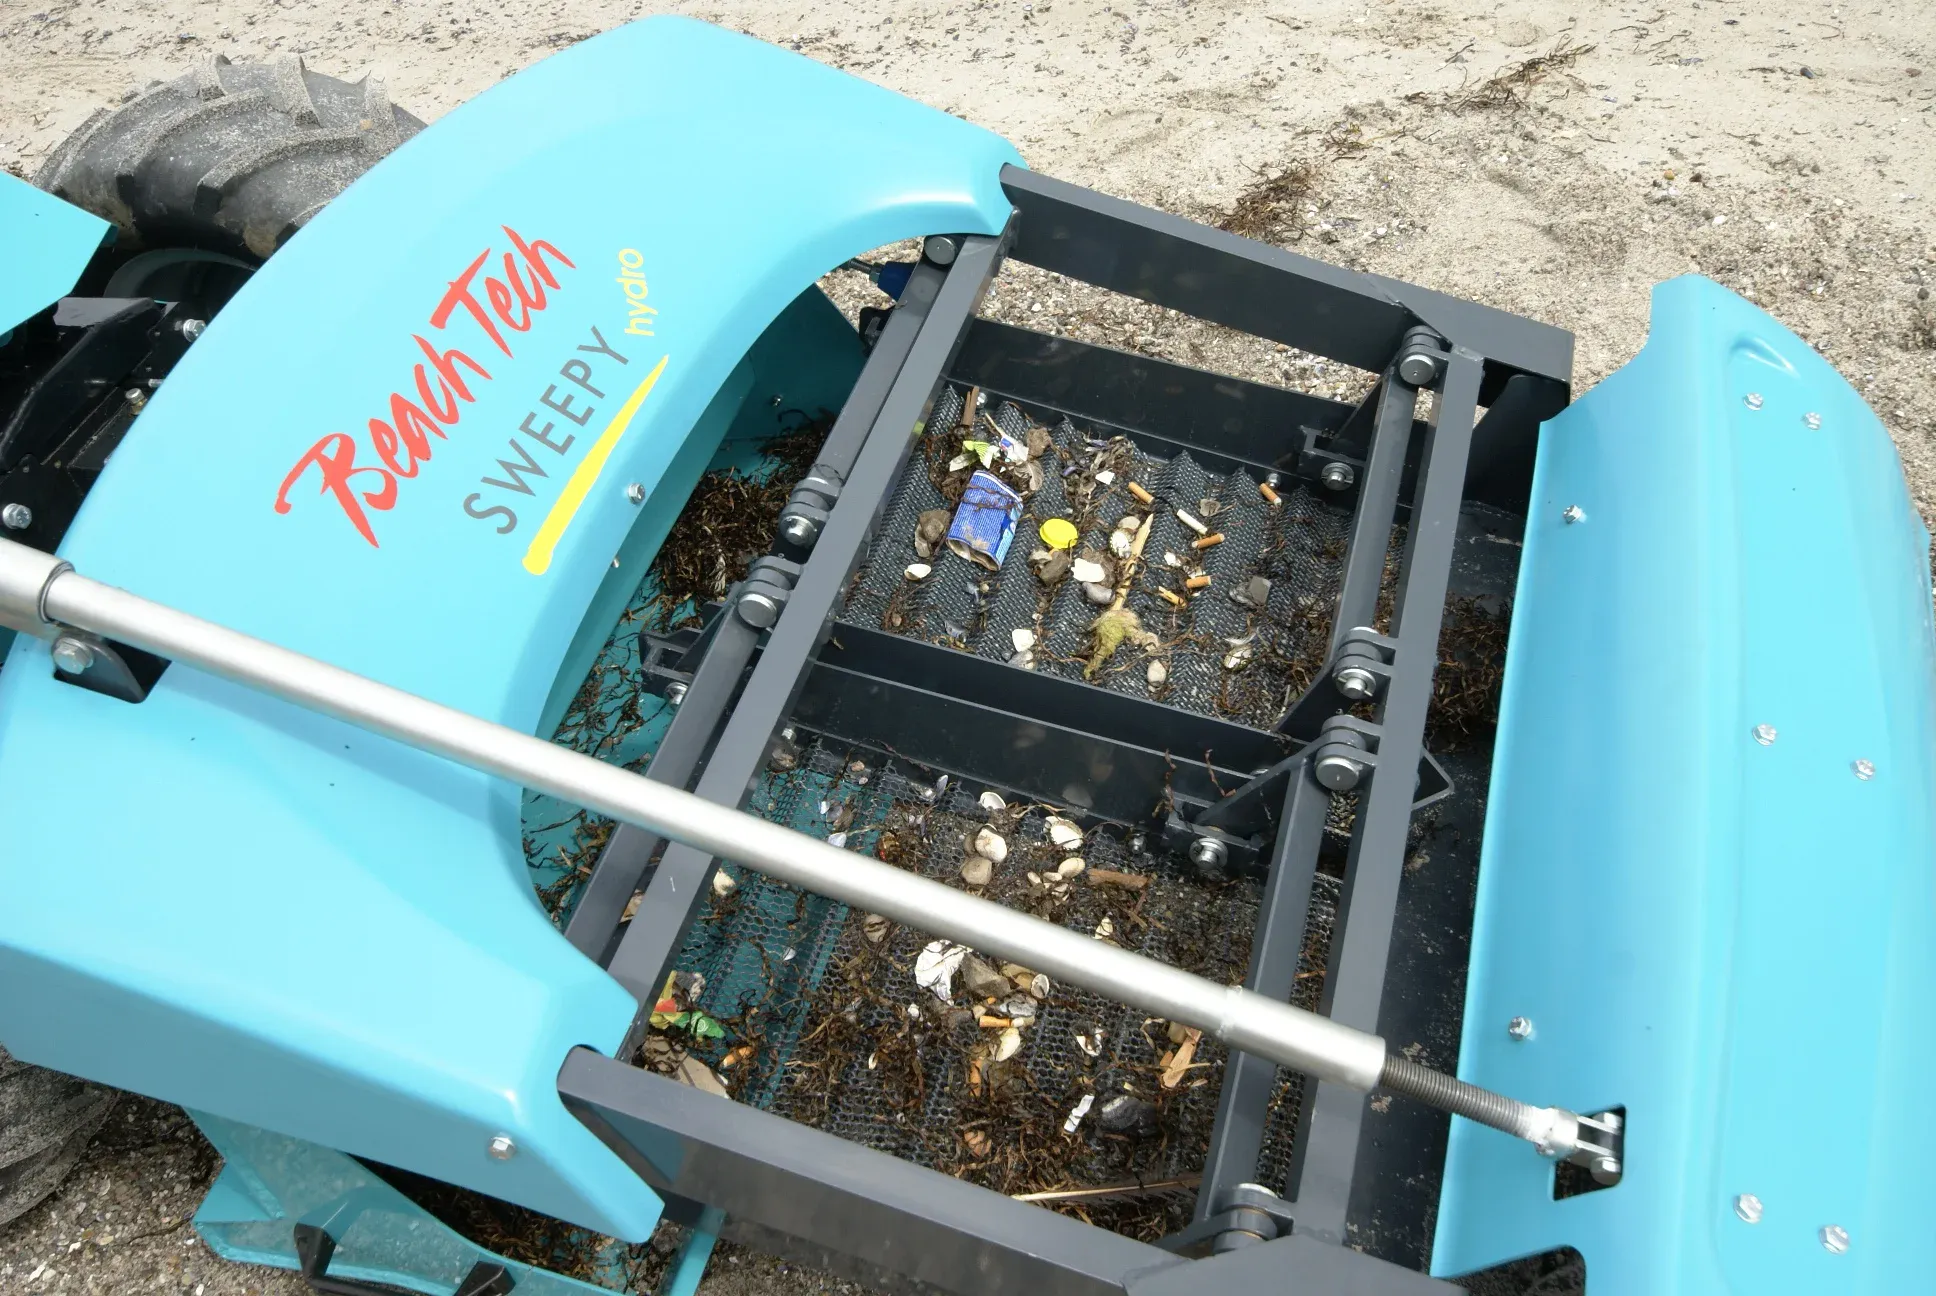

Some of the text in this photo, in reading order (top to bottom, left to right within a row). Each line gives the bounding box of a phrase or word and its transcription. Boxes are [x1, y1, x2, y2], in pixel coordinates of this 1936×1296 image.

[274, 225, 577, 549] Beach Tech
[616, 248, 658, 337] hydro
[463, 326, 629, 535] SWEEPY
